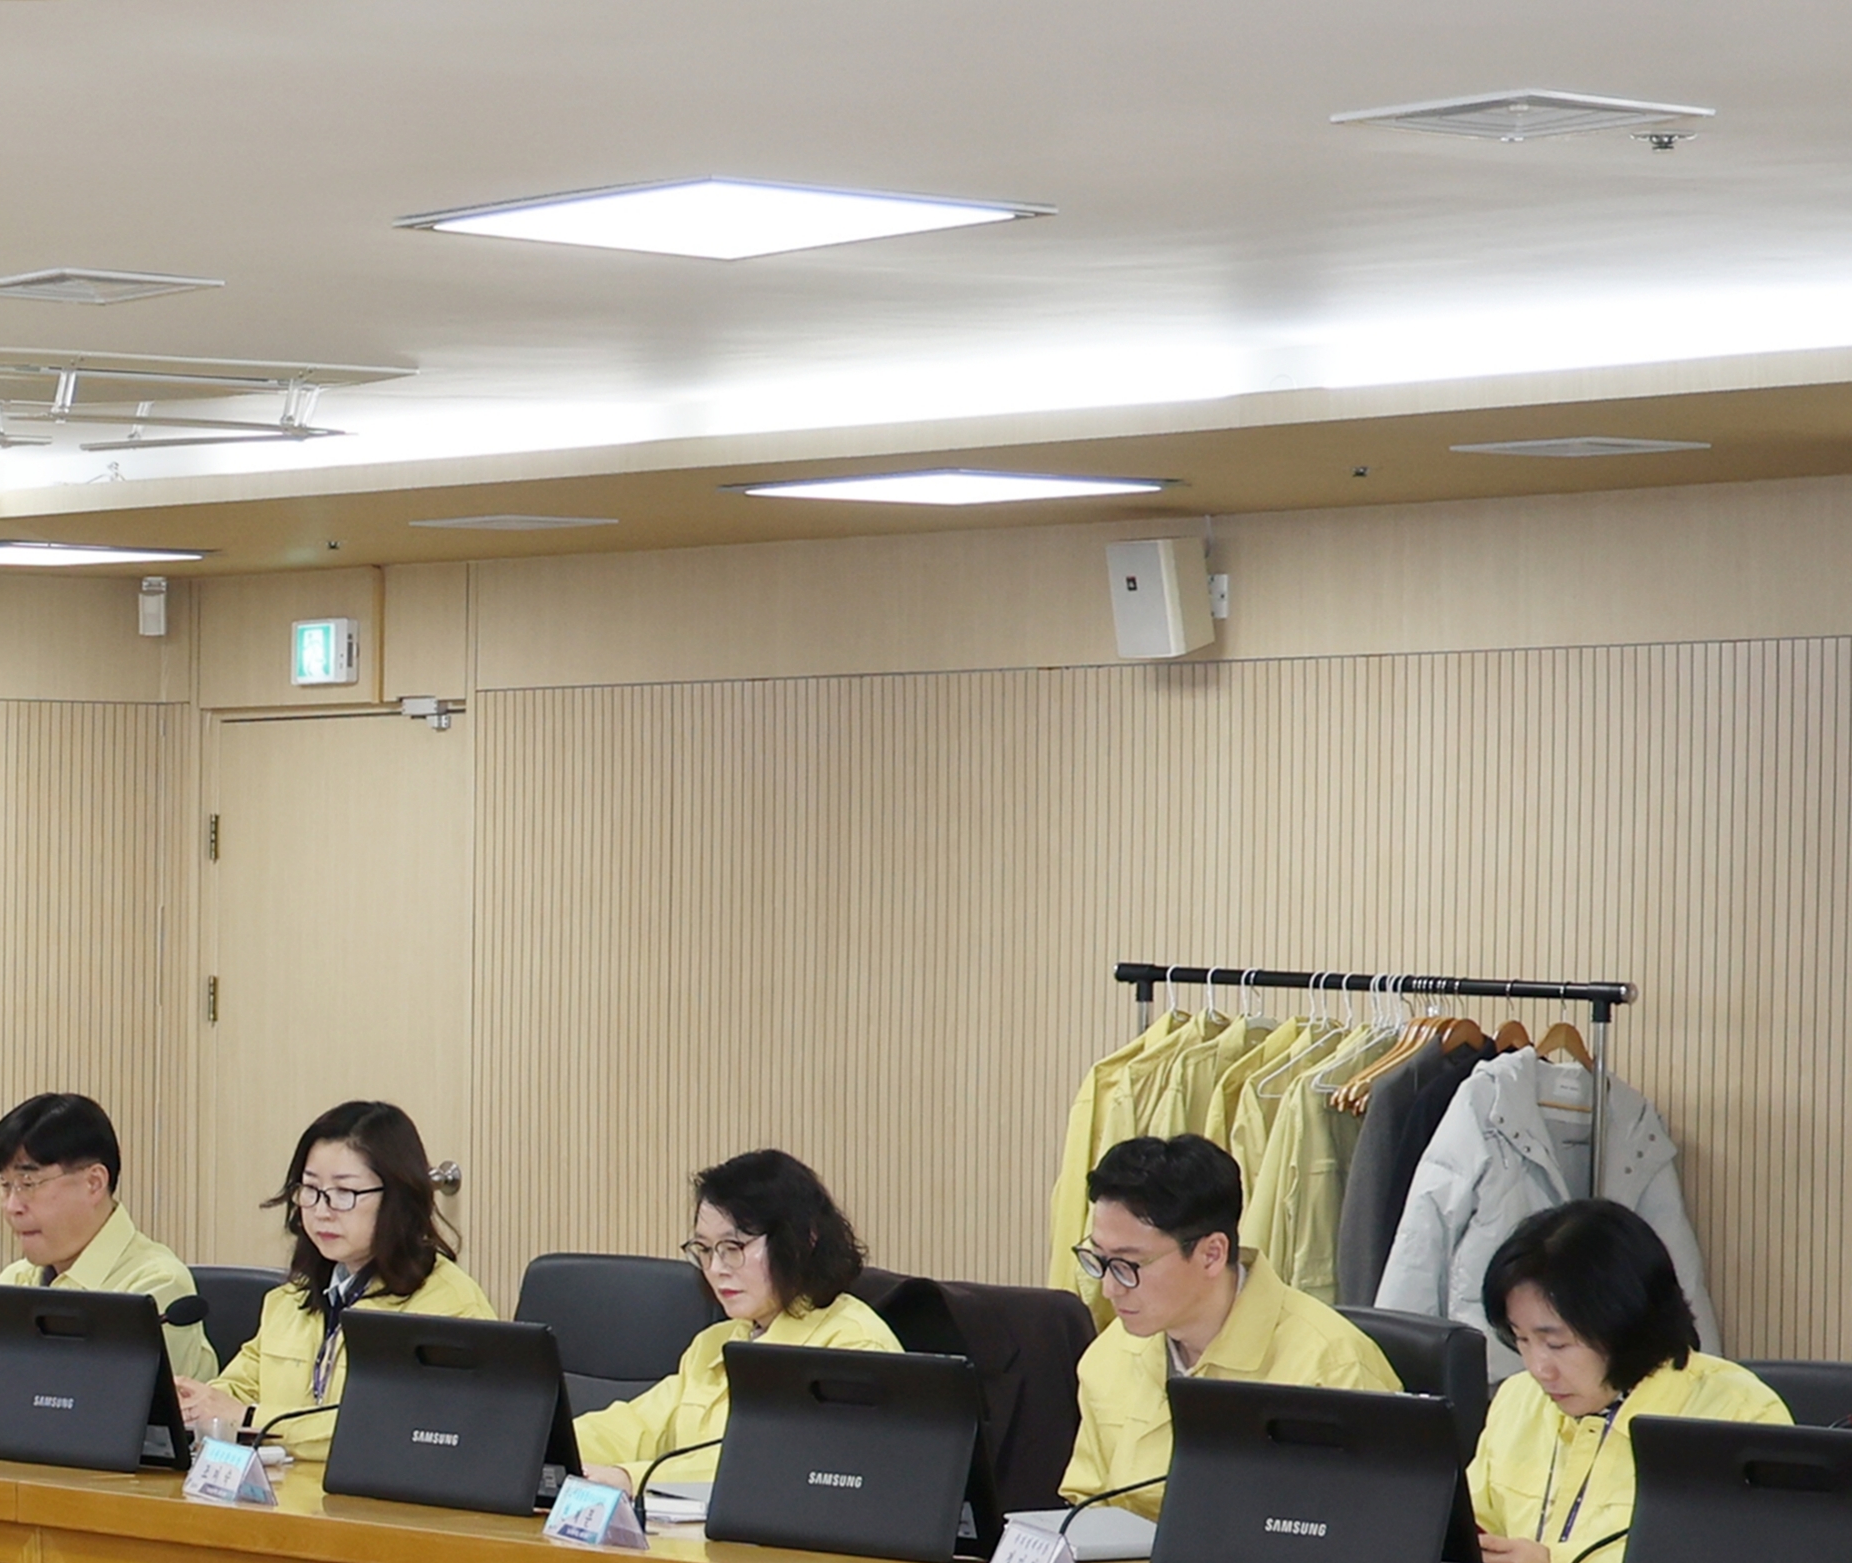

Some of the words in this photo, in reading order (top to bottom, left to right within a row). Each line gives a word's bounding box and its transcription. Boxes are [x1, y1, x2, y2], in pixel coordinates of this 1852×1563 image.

[31, 1393, 76, 1411] SAMSUNG
[410, 1428, 460, 1448] SAMSUNG
[806, 1470, 864, 1490] SAMSUNG
[1263, 1516, 1328, 1537] SAMSUNG
